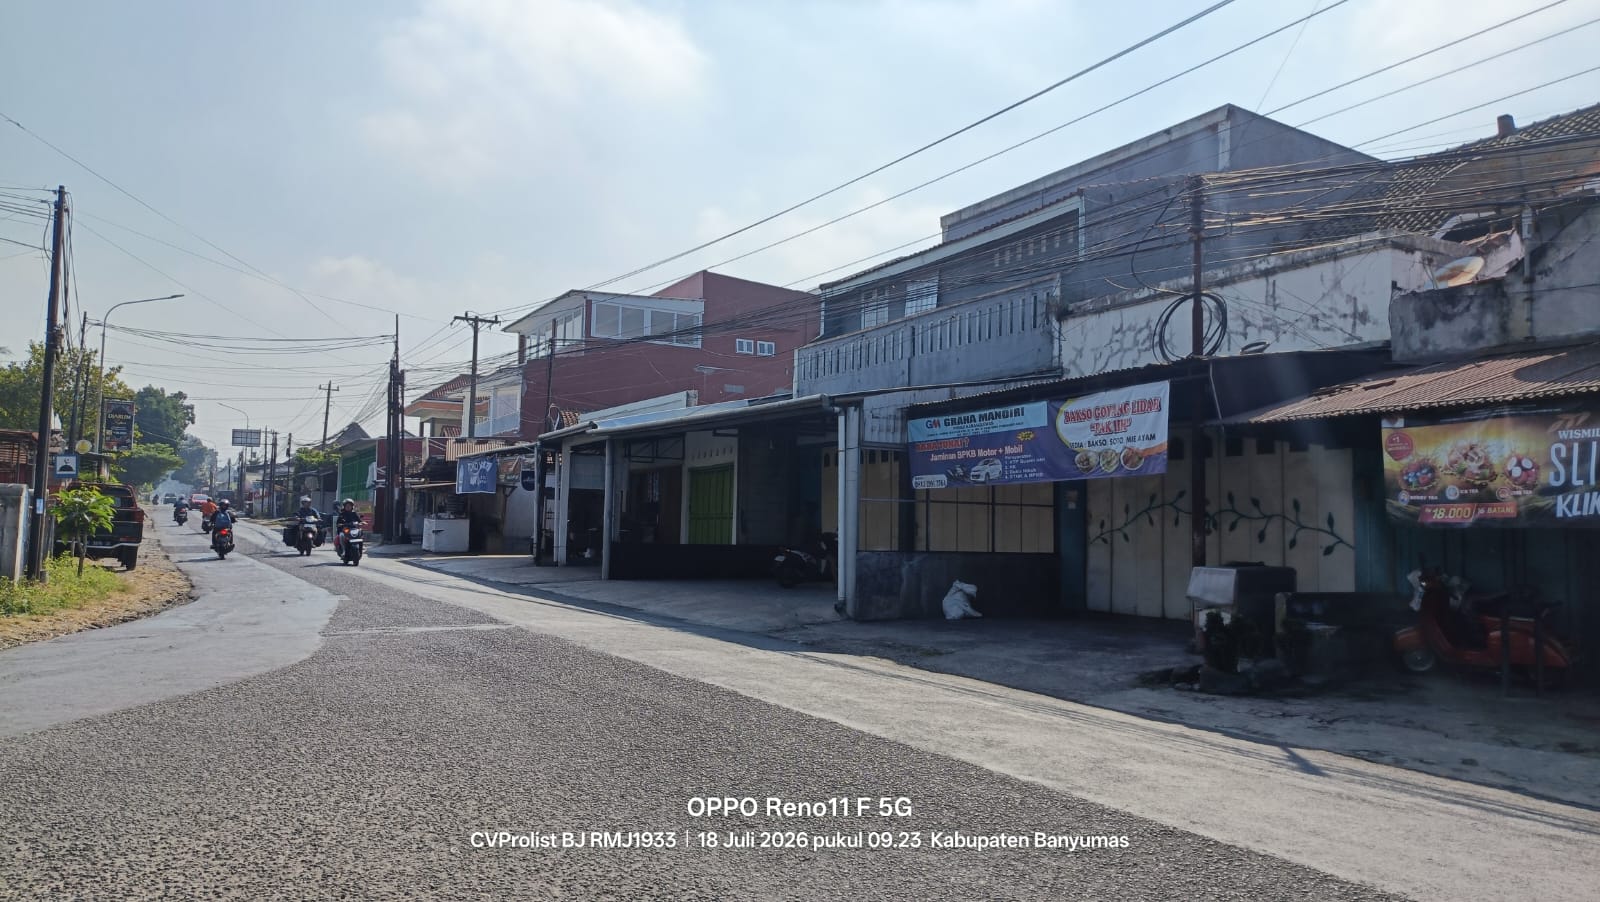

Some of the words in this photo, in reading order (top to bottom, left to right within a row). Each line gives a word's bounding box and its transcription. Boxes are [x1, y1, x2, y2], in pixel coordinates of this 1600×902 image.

[944, 414, 977, 427] GRAHA
[978, 407, 1025, 422] MANDIRI
[1064, 408, 1092, 424] BAKSO
[1131, 397, 1161, 415] LIDAH
[1087, 439, 1107, 448] BAKSO
[1126, 435, 1137, 444] MIE
[1137, 433, 1156, 443] AYAM
[931, 453, 956, 461] Jaminan
[957, 449, 977, 459] BPKB
[977, 447, 998, 457] Motor
[1004, 444, 1024, 455] Mobil
[1549, 440, 1598, 487] SLI
[1433, 507, 1472, 520] 18.000
